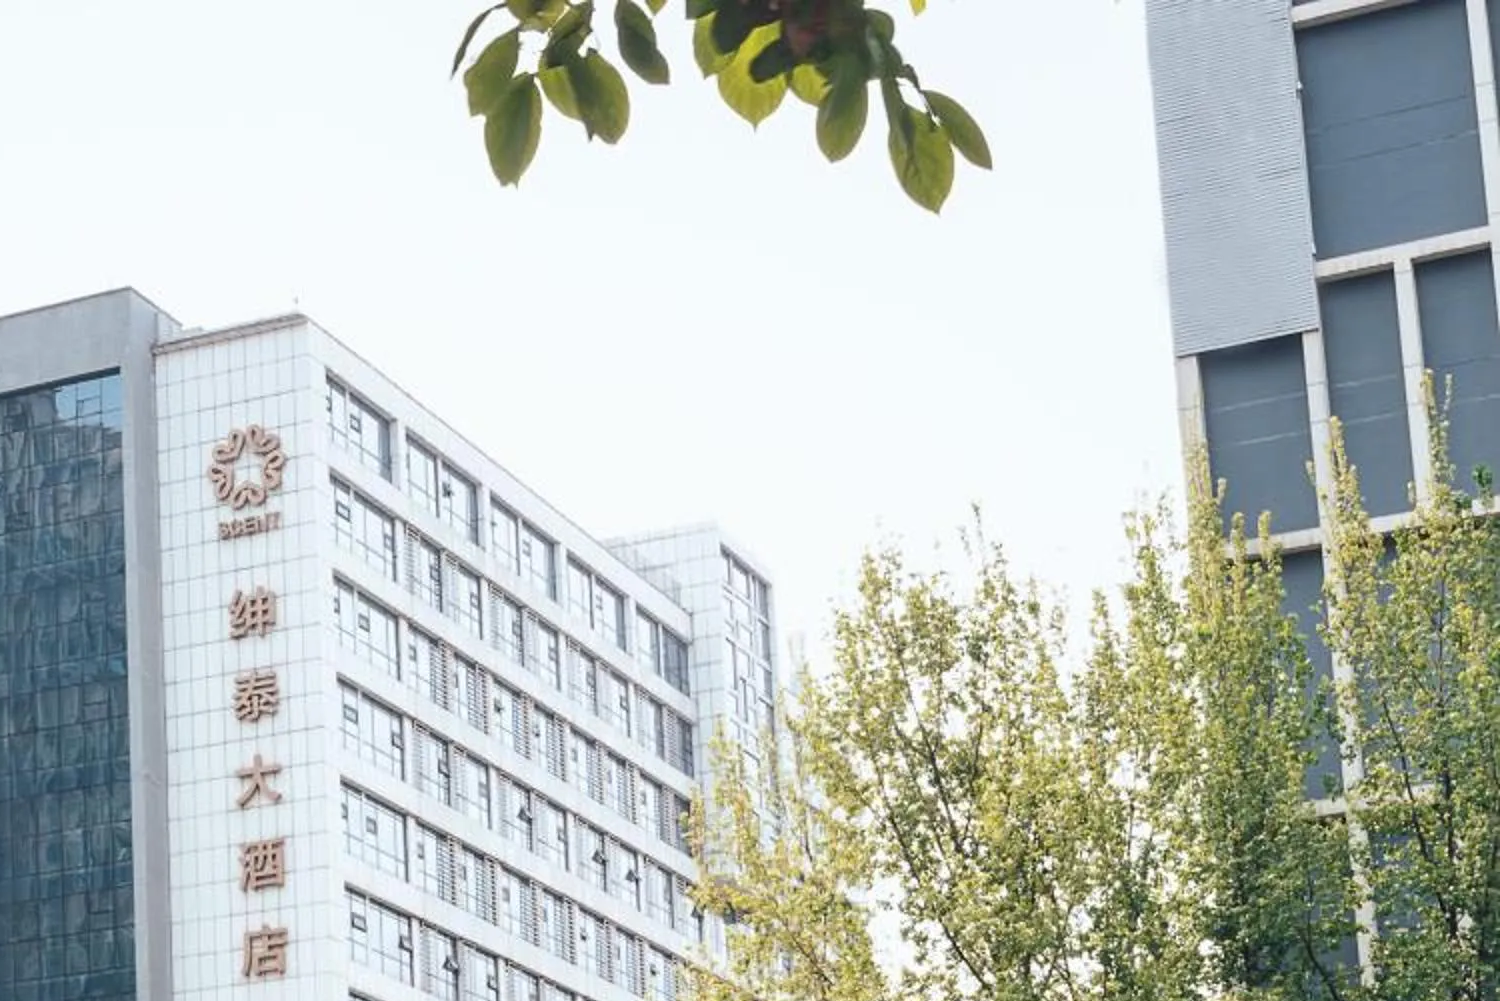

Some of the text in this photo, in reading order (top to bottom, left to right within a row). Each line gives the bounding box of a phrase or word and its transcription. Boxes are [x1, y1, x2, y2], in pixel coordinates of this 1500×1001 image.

[227, 585, 289, 980] 绅泰大酒店
